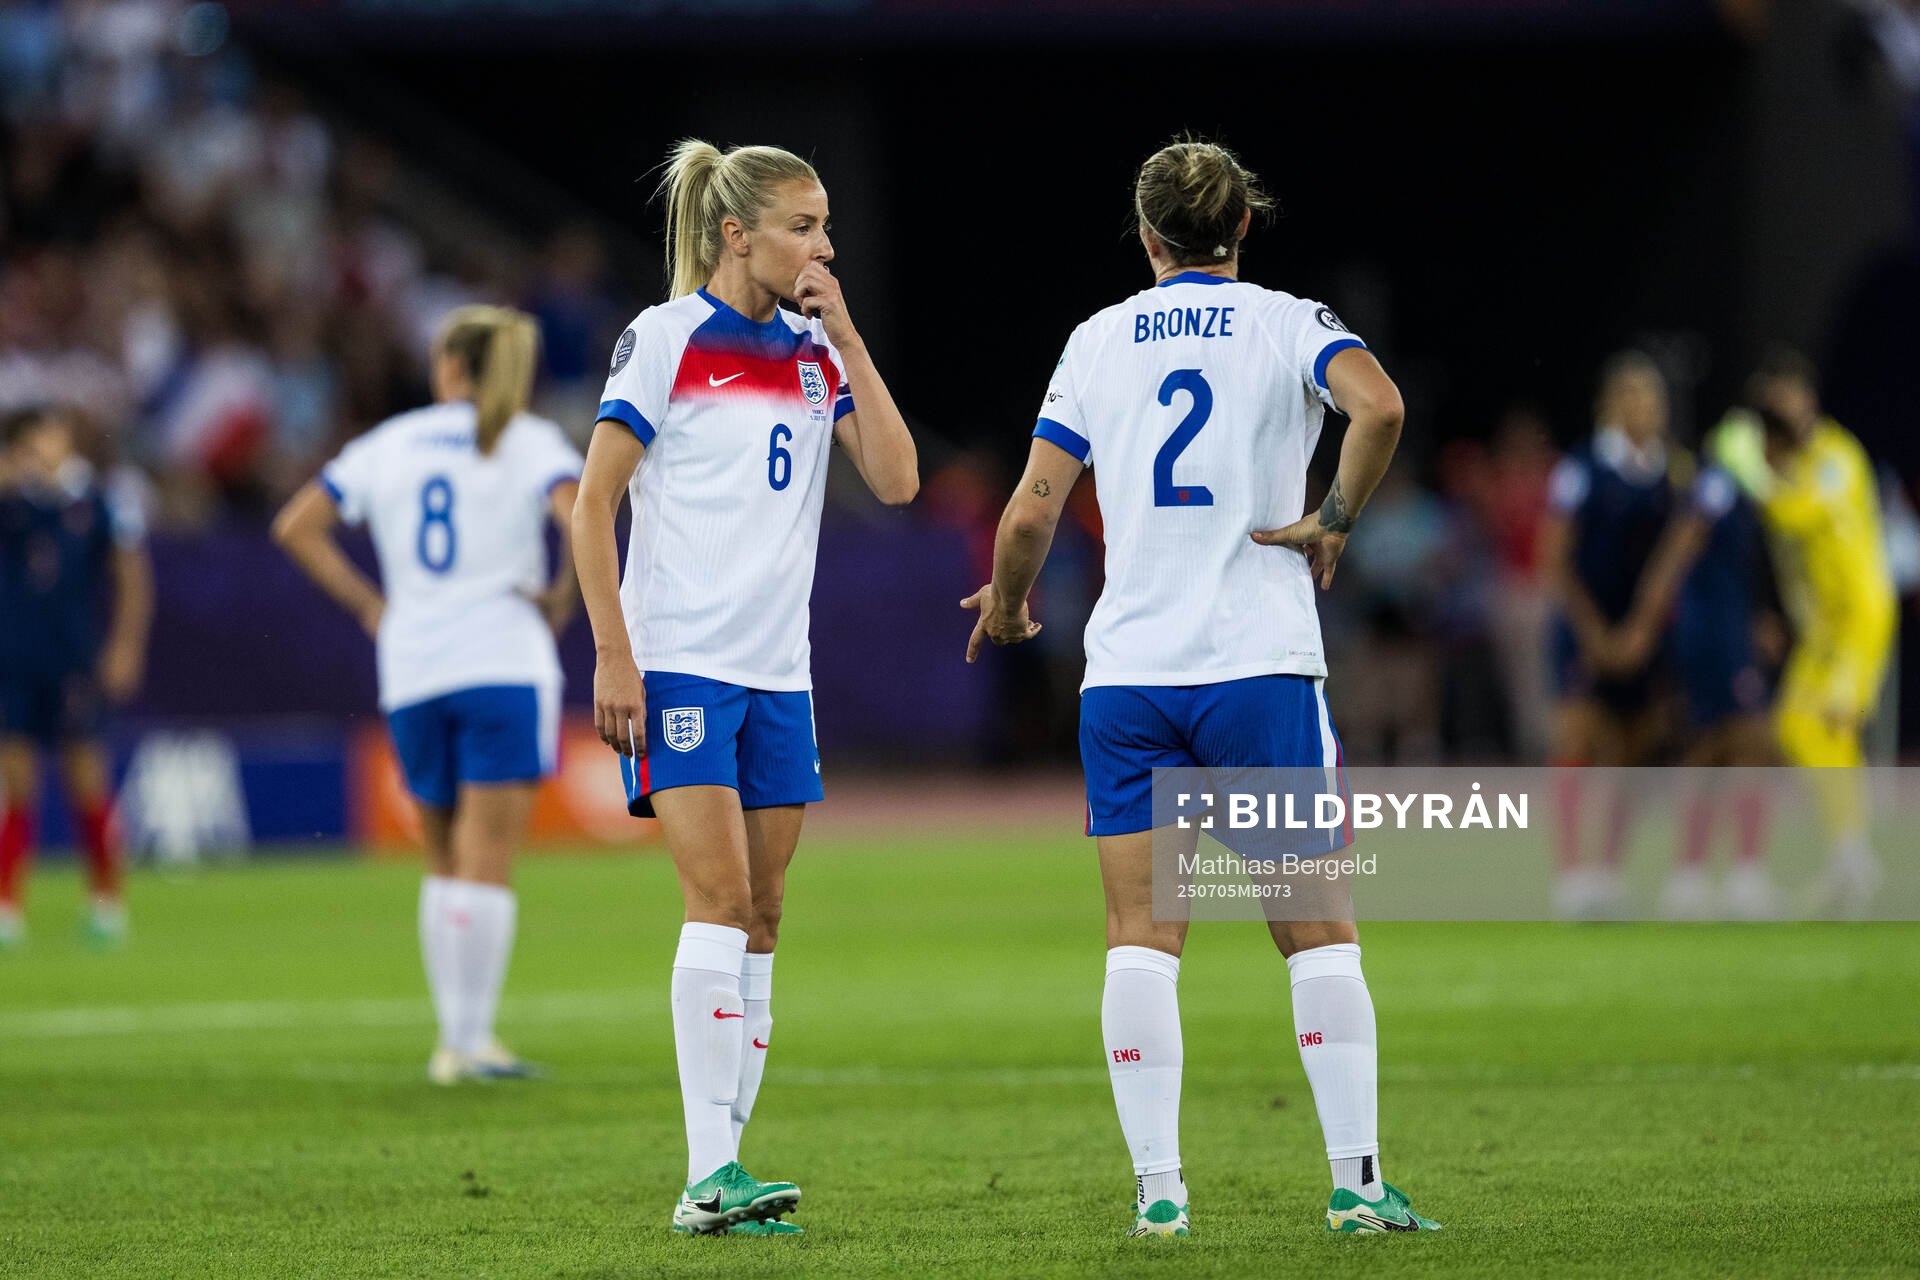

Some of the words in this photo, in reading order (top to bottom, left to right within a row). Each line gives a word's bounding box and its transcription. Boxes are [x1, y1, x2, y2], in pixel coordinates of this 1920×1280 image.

[1134, 307, 1235, 343] BRONZE
[767, 423, 793, 491] 6
[1153, 368, 1214, 507] 2
[416, 474, 457, 573] 8
[1112, 1049, 1141, 1063] ENG
[1299, 1032, 1323, 1048] ENG
